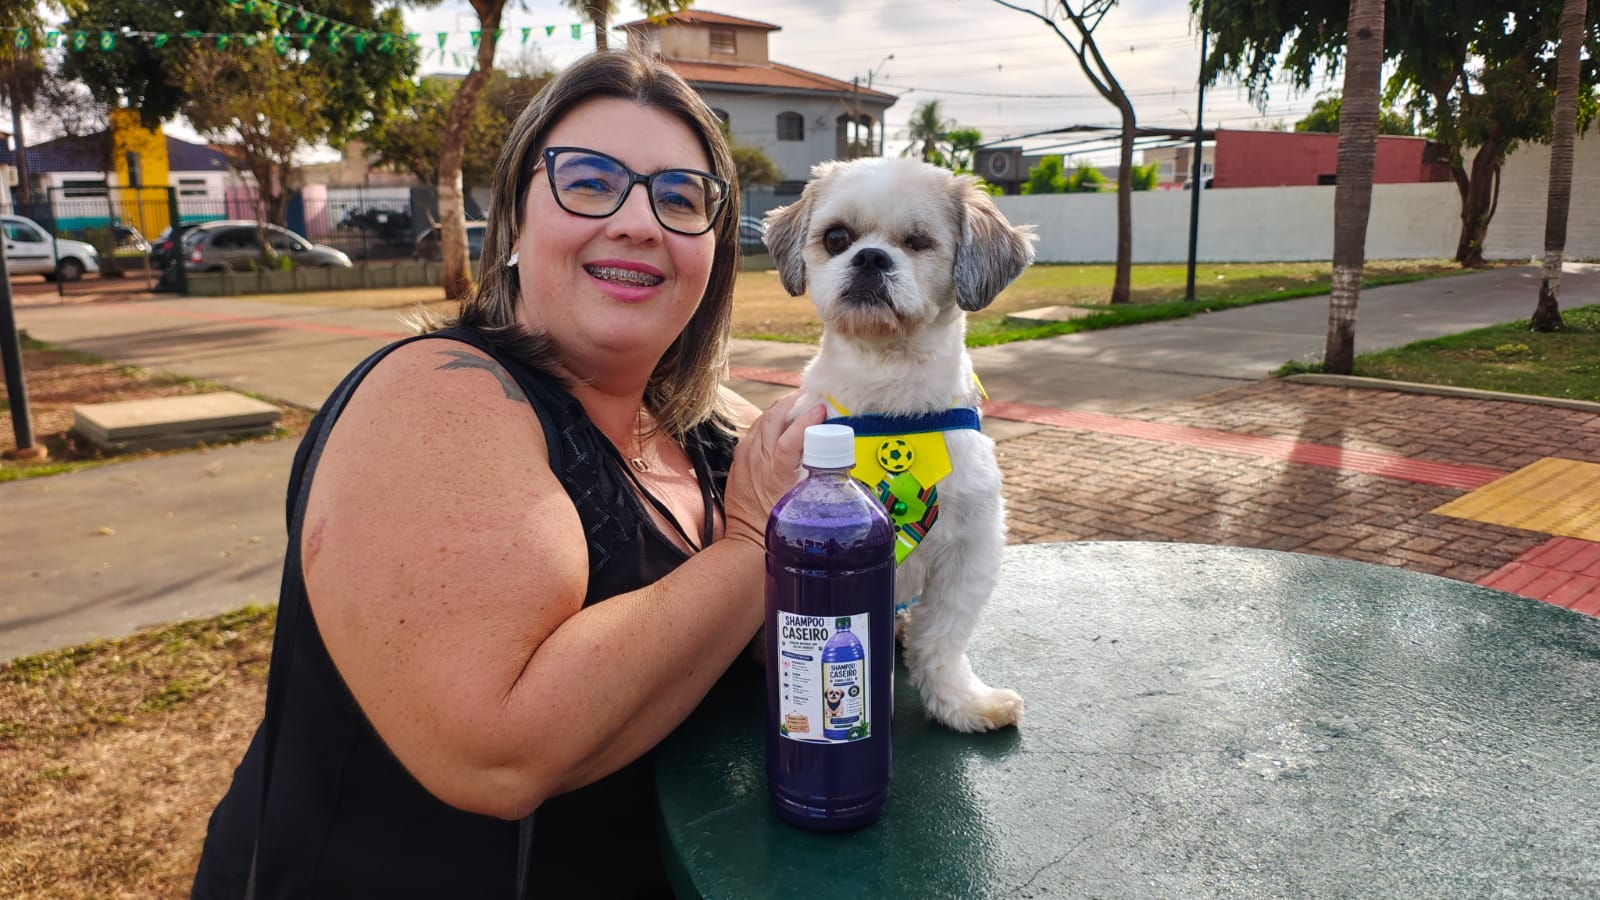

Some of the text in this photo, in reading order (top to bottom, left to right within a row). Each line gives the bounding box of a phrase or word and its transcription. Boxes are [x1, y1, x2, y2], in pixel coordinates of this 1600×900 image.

[785, 615, 825, 627] SHAMPOO
[782, 626, 829, 641] CASEIRO
[831, 663, 855, 671] SHAMPOO
[830, 669, 857, 678] CASEIRO
